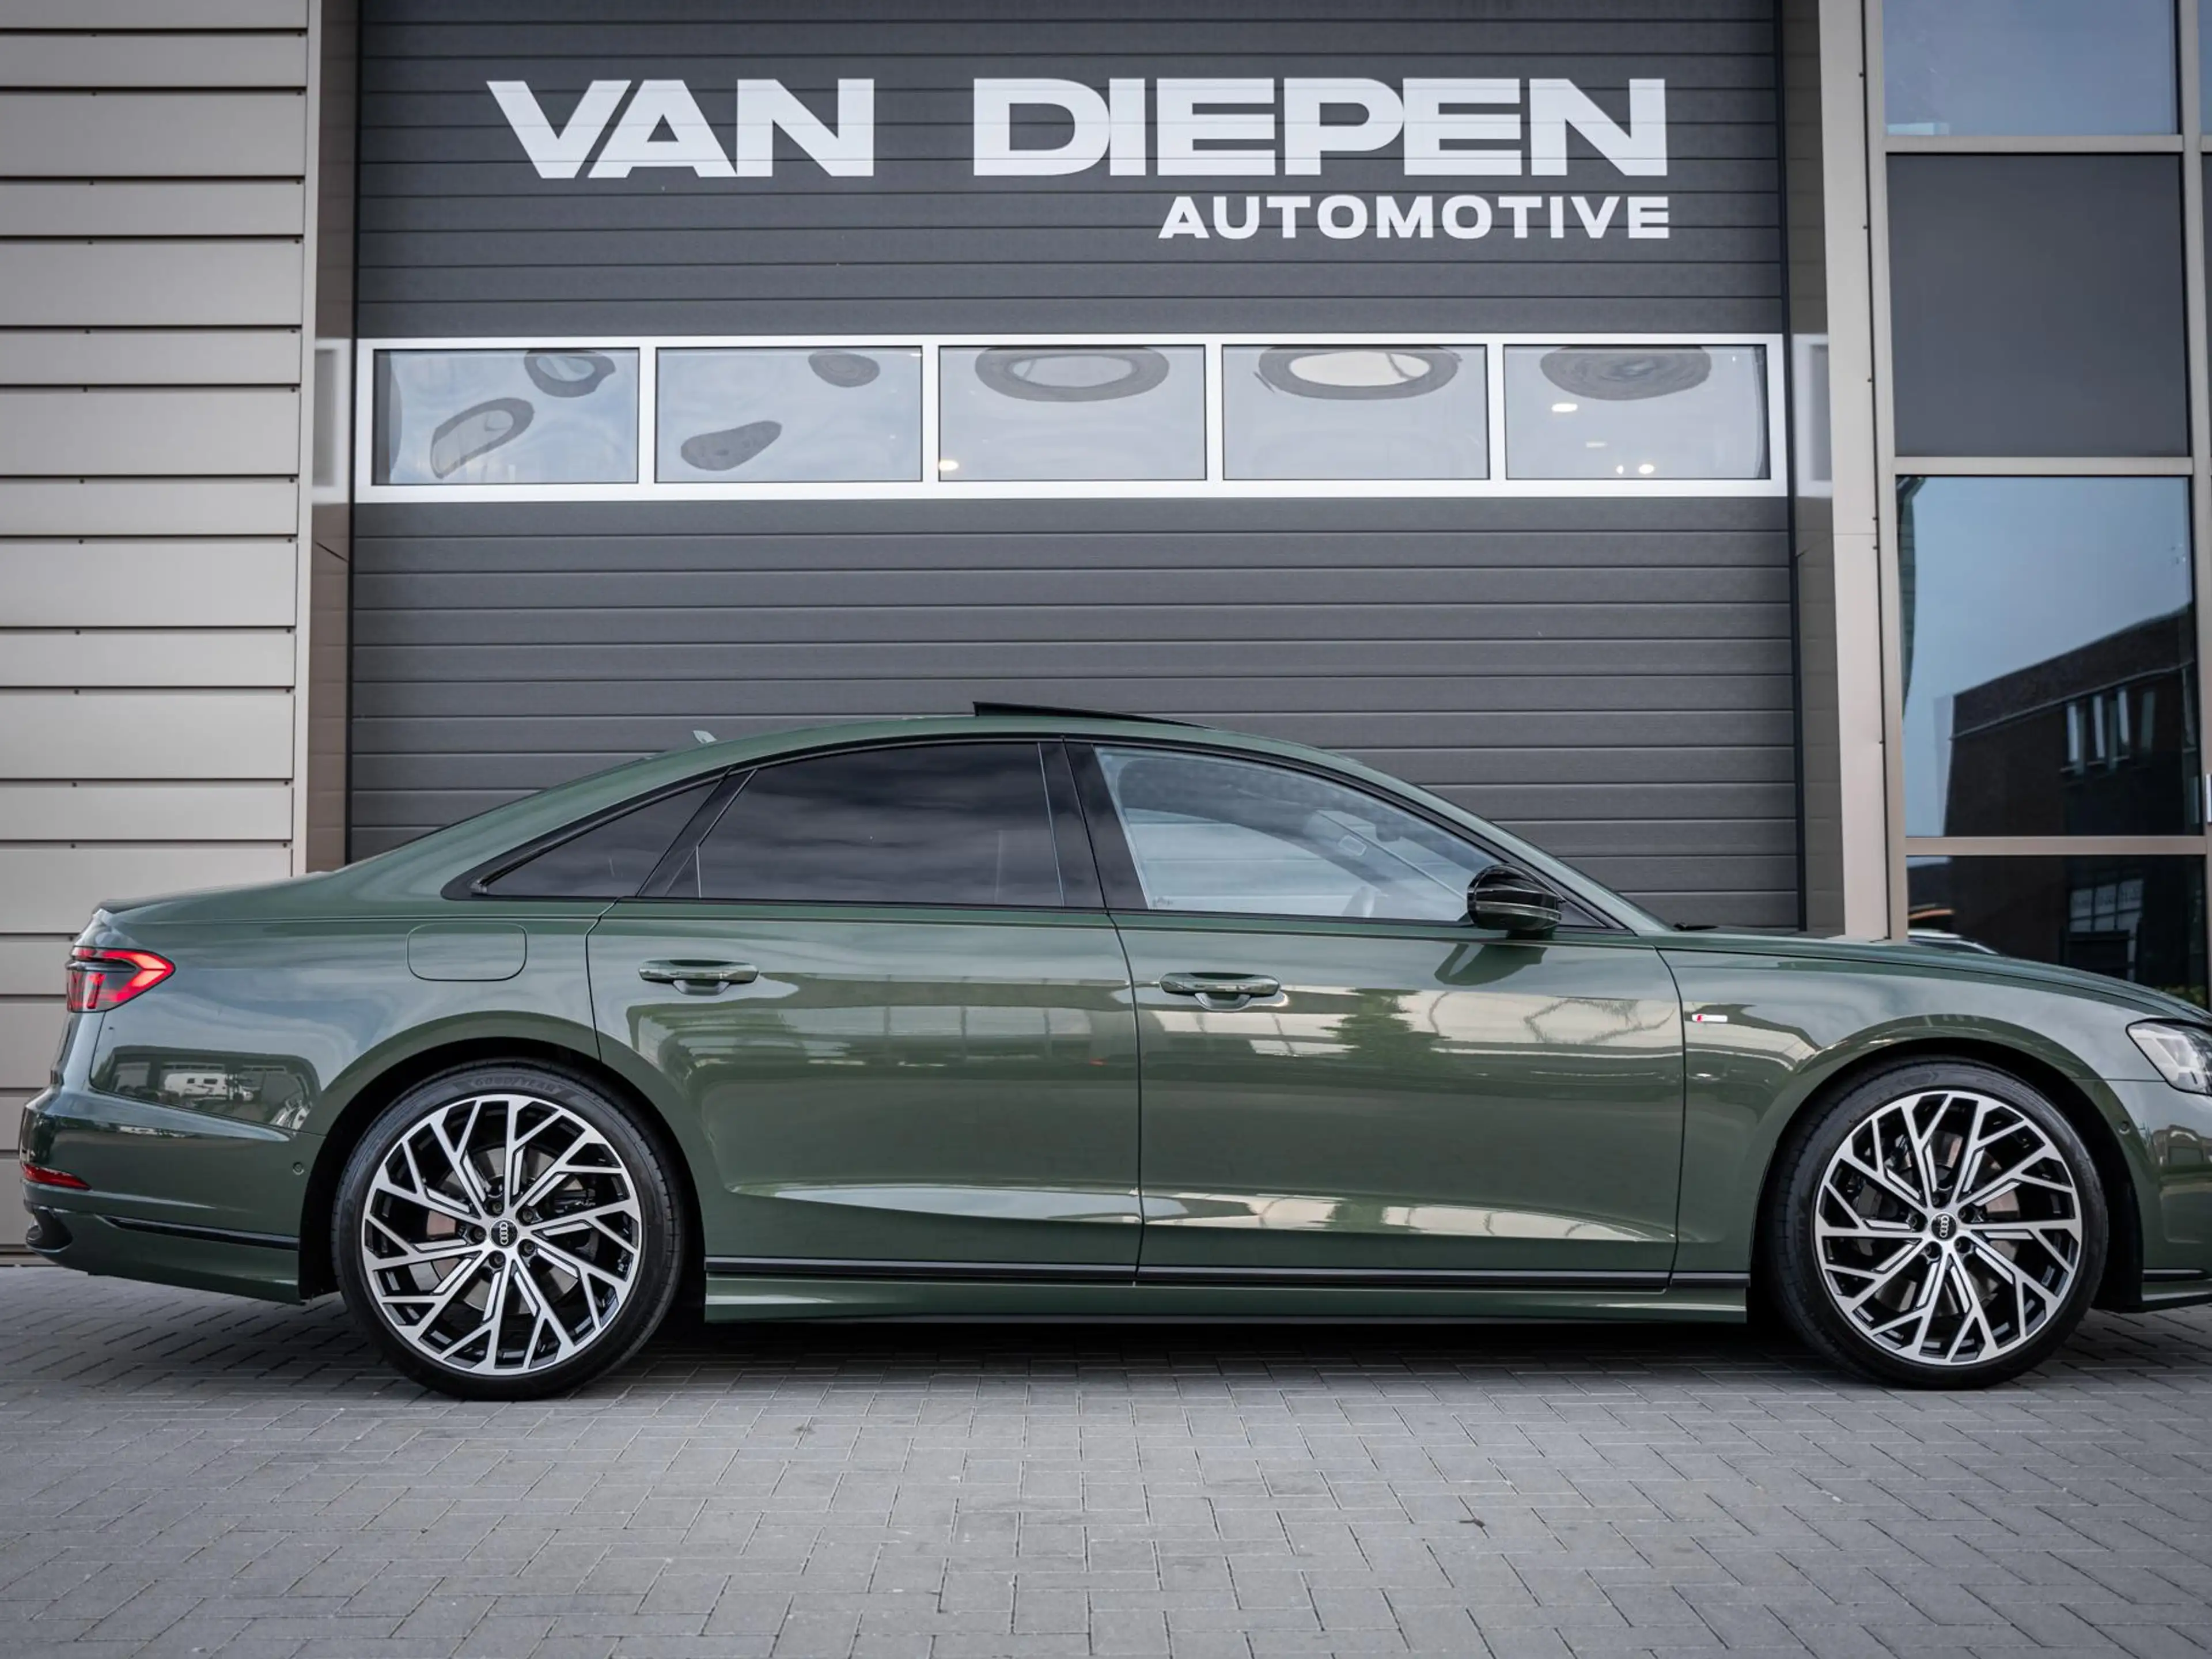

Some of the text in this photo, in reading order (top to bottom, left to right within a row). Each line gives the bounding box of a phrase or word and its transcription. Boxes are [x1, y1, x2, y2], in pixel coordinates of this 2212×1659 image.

[486, 78, 1668, 179] VAN DIEPEN
[1158, 194, 1669, 240] AUTOMOTIVE
